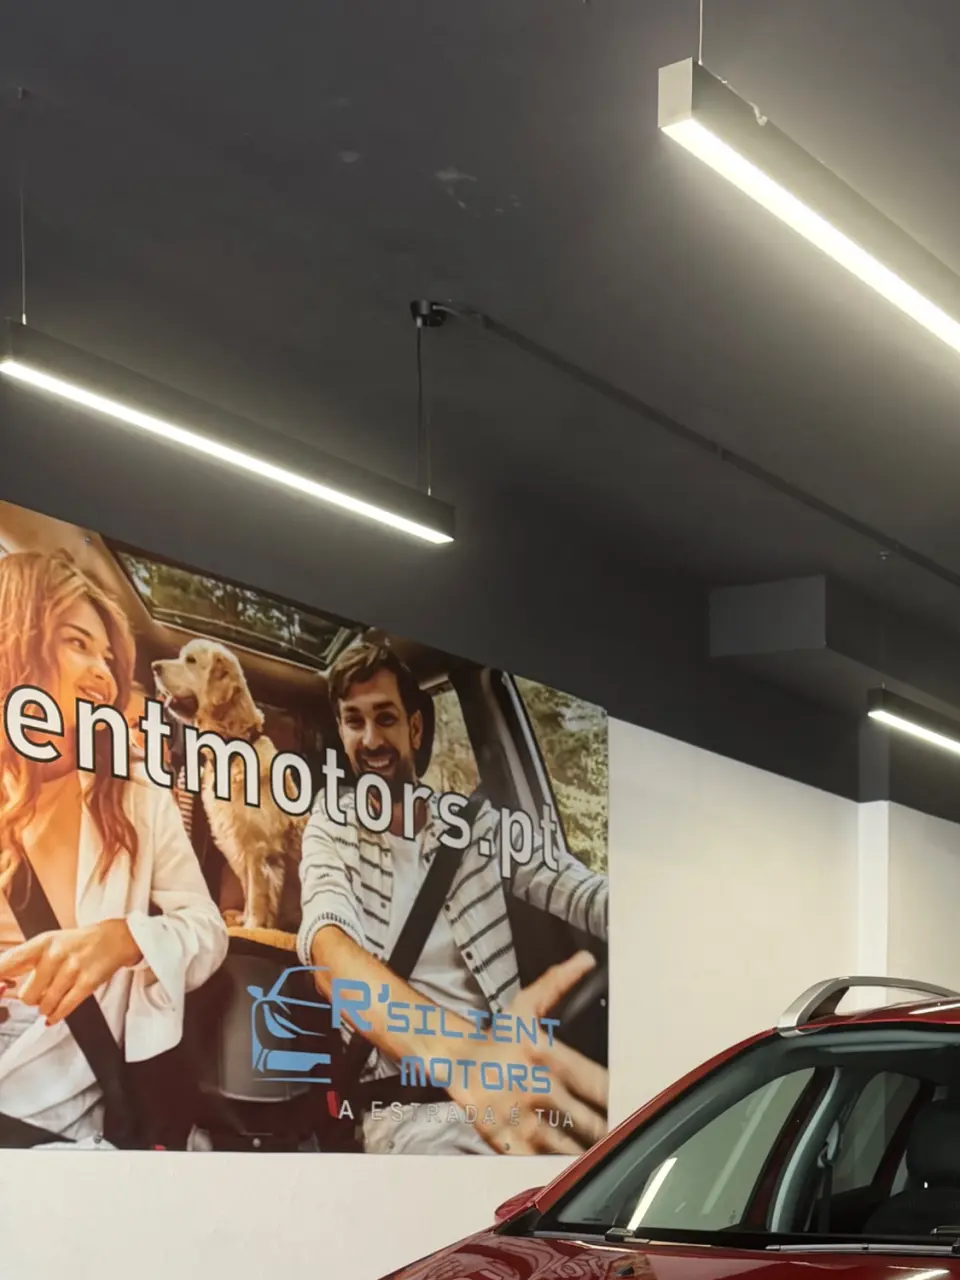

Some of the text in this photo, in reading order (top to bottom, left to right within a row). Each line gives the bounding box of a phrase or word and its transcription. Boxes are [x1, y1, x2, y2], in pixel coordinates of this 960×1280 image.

[3, 683, 560, 879] entmotors.pt
[400, 1054, 552, 1095] MOTORS
[337, 1100, 575, 1128] A ESTRADA É TUA
